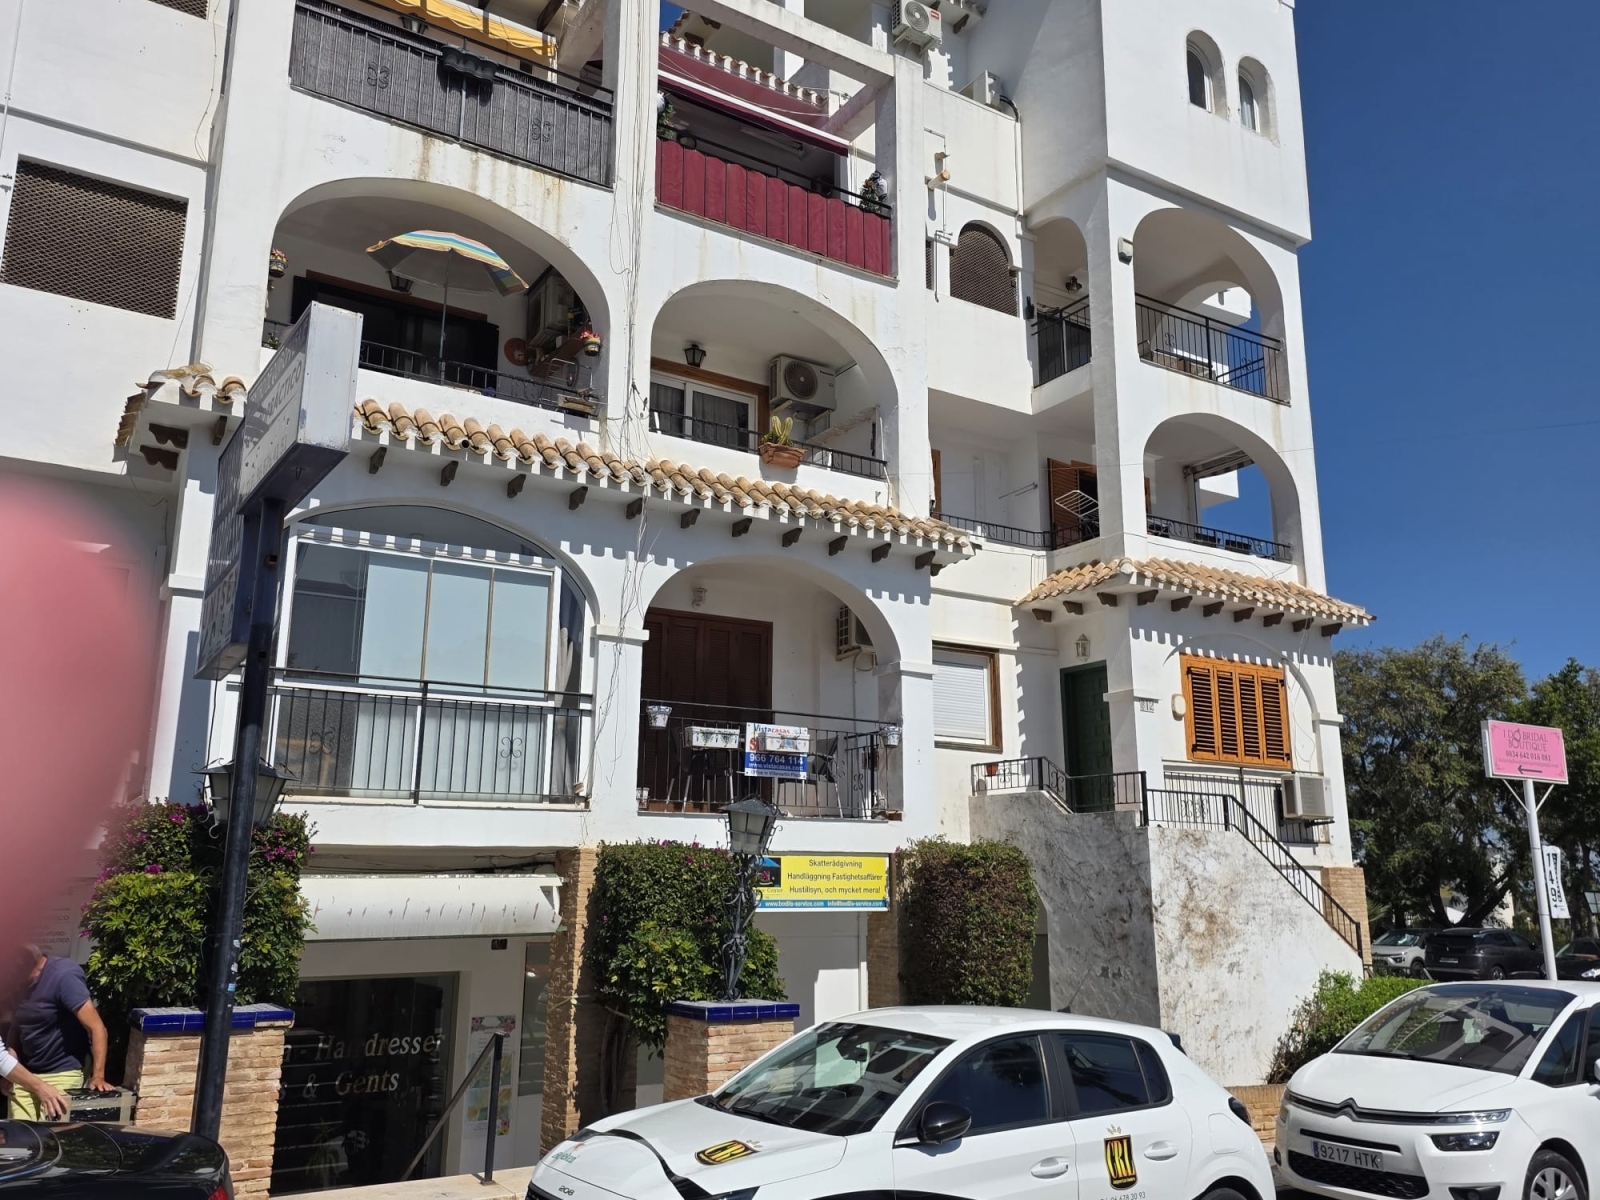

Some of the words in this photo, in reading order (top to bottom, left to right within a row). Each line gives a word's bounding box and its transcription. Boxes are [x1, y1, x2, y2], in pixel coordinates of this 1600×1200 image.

[754, 724, 790, 734] Vistacasas
[1507, 729, 1521, 741] DO
[1523, 731, 1548, 743] BRIDAL
[1508, 739, 1547, 752] BOUTIQUE
[750, 753, 766, 762] 966
[769, 754, 786, 763] 764
[788, 756, 804, 765] 114
[809, 859, 862, 869] Skatterådgivning
[787, 872, 831, 882] Handläggning
[832, 873, 882, 882] Fastighetsaffärer
[838, 886, 862, 895] mycket
[314, 1033, 443, 1061] Hadresser
[335, 1070, 399, 1096] Gents
[1320, 1145, 1349, 1162] 9217
[1354, 1151, 1380, 1169] HTK
[558, 1185, 575, 1196] 208
[1139, 1191, 1146, 1199] 93
